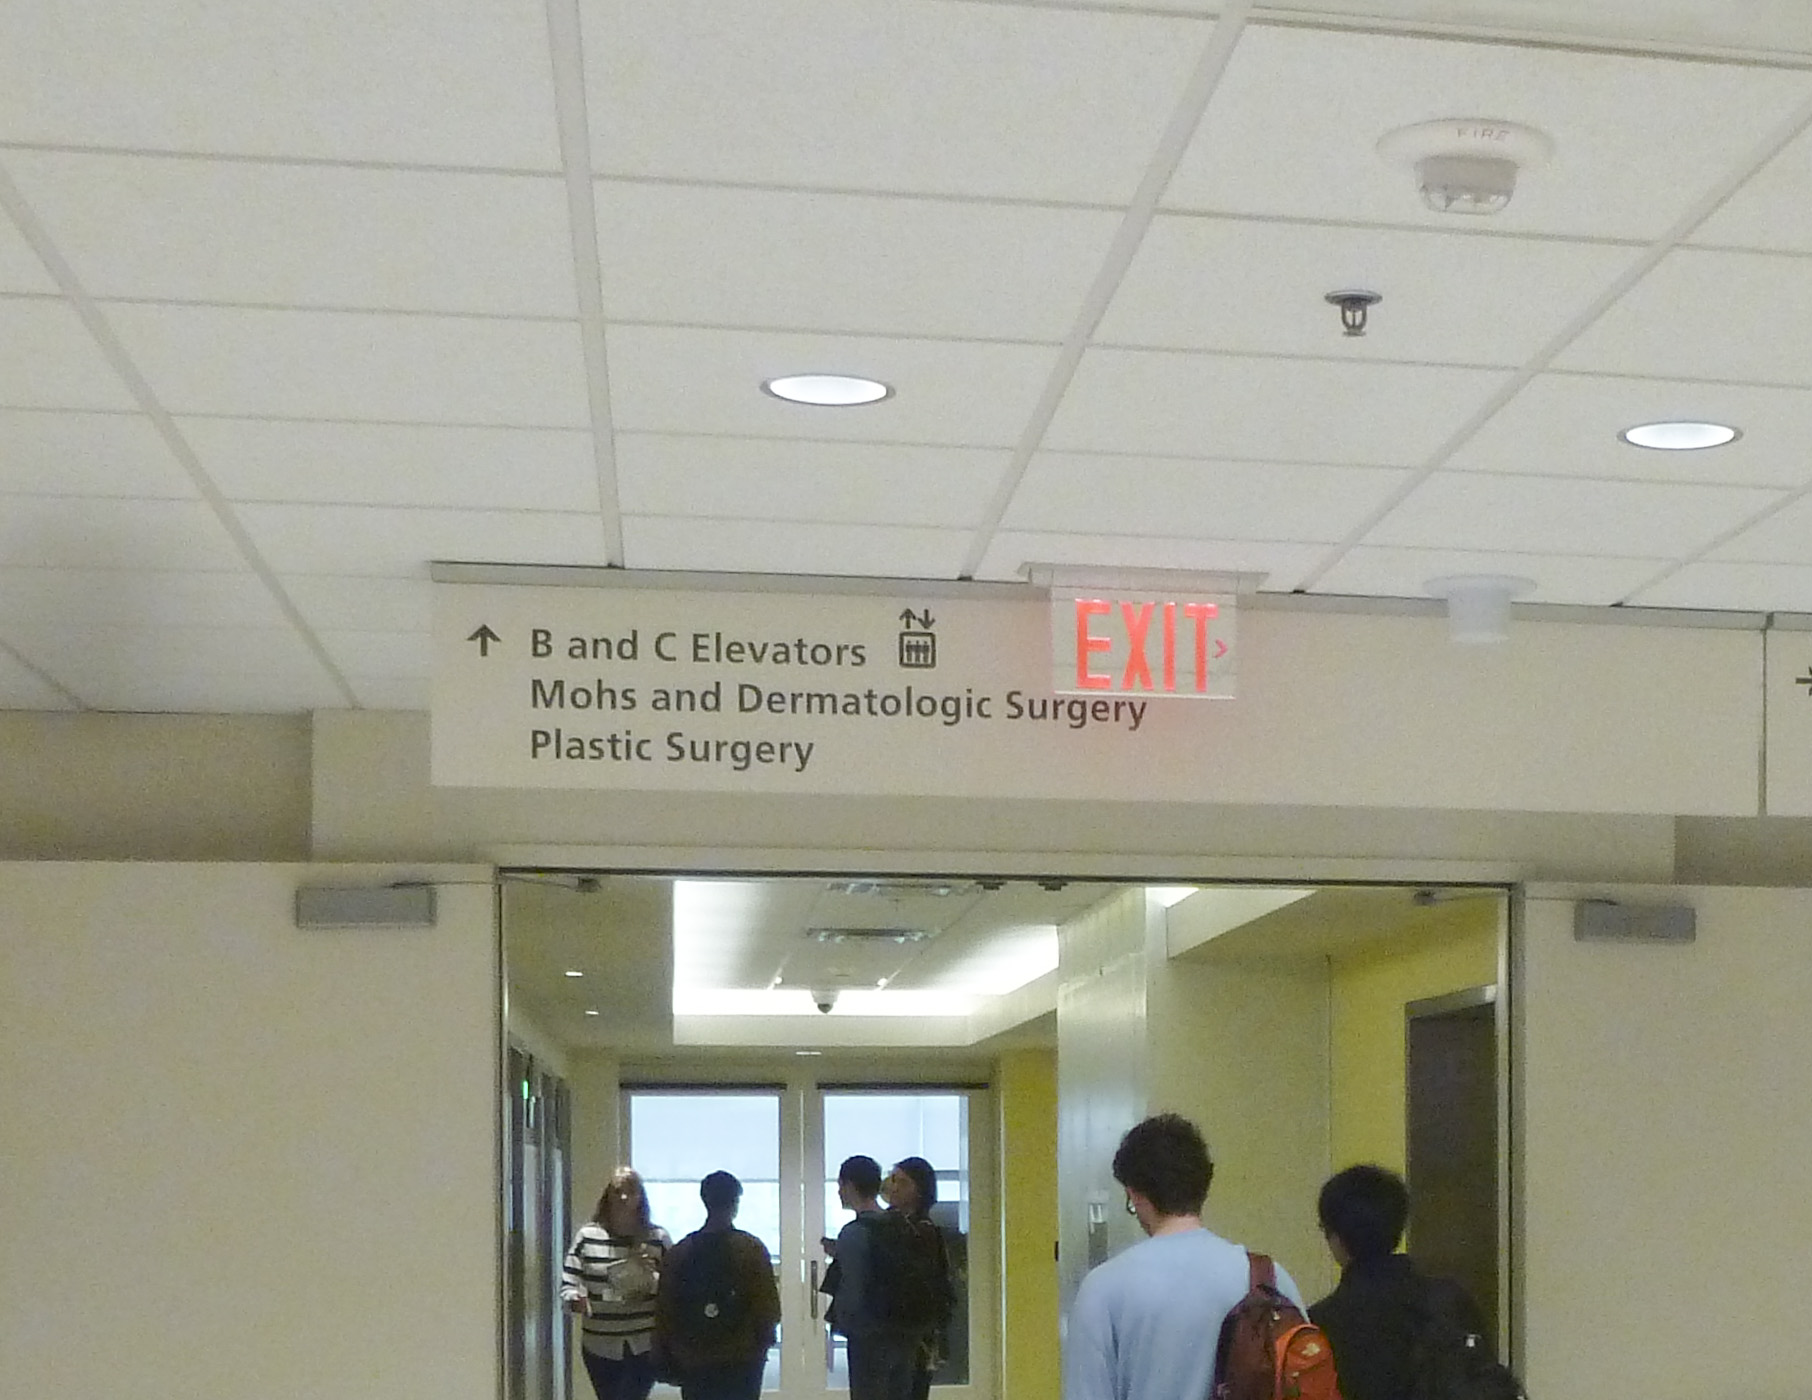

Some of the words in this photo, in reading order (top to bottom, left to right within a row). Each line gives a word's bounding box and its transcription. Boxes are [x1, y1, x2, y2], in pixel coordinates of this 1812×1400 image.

[531, 628, 553, 658] B
[567, 629, 639, 661] and
[655, 632, 677, 662] C
[692, 631, 867, 666] Elevators
[1075, 599, 1219, 693] EXIT
[531, 678, 637, 711] Mohs
[651, 681, 722, 713] and
[738, 682, 992, 727] Dermatologic
[1006, 690, 1148, 732] Surgery
[531, 728, 652, 762] Plastic
[666, 732, 815, 773] Surgery
